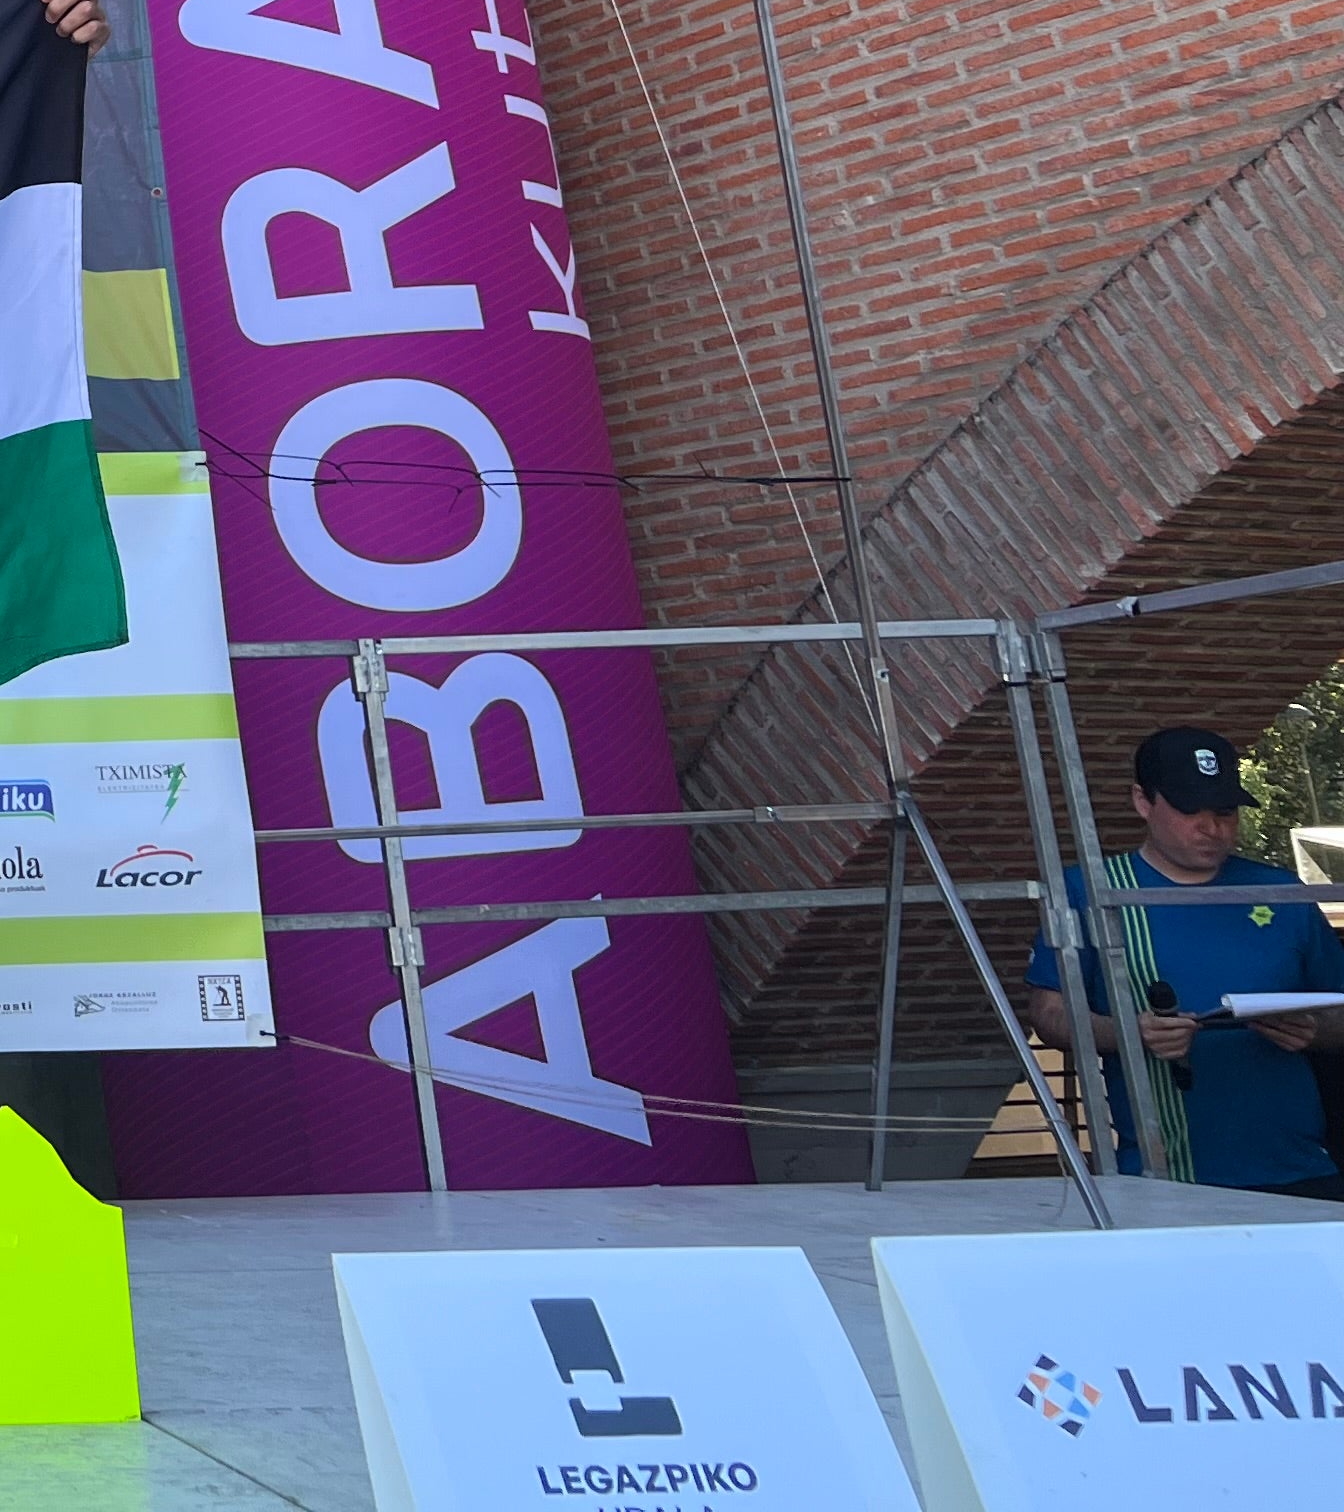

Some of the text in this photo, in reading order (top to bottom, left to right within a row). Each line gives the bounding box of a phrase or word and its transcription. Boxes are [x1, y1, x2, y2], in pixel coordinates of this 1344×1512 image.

[95, 764, 188, 780] TXIMISTA
[96, 868, 202, 888] Lacor
[536, 1462, 759, 1495] LEGAZPIKO
